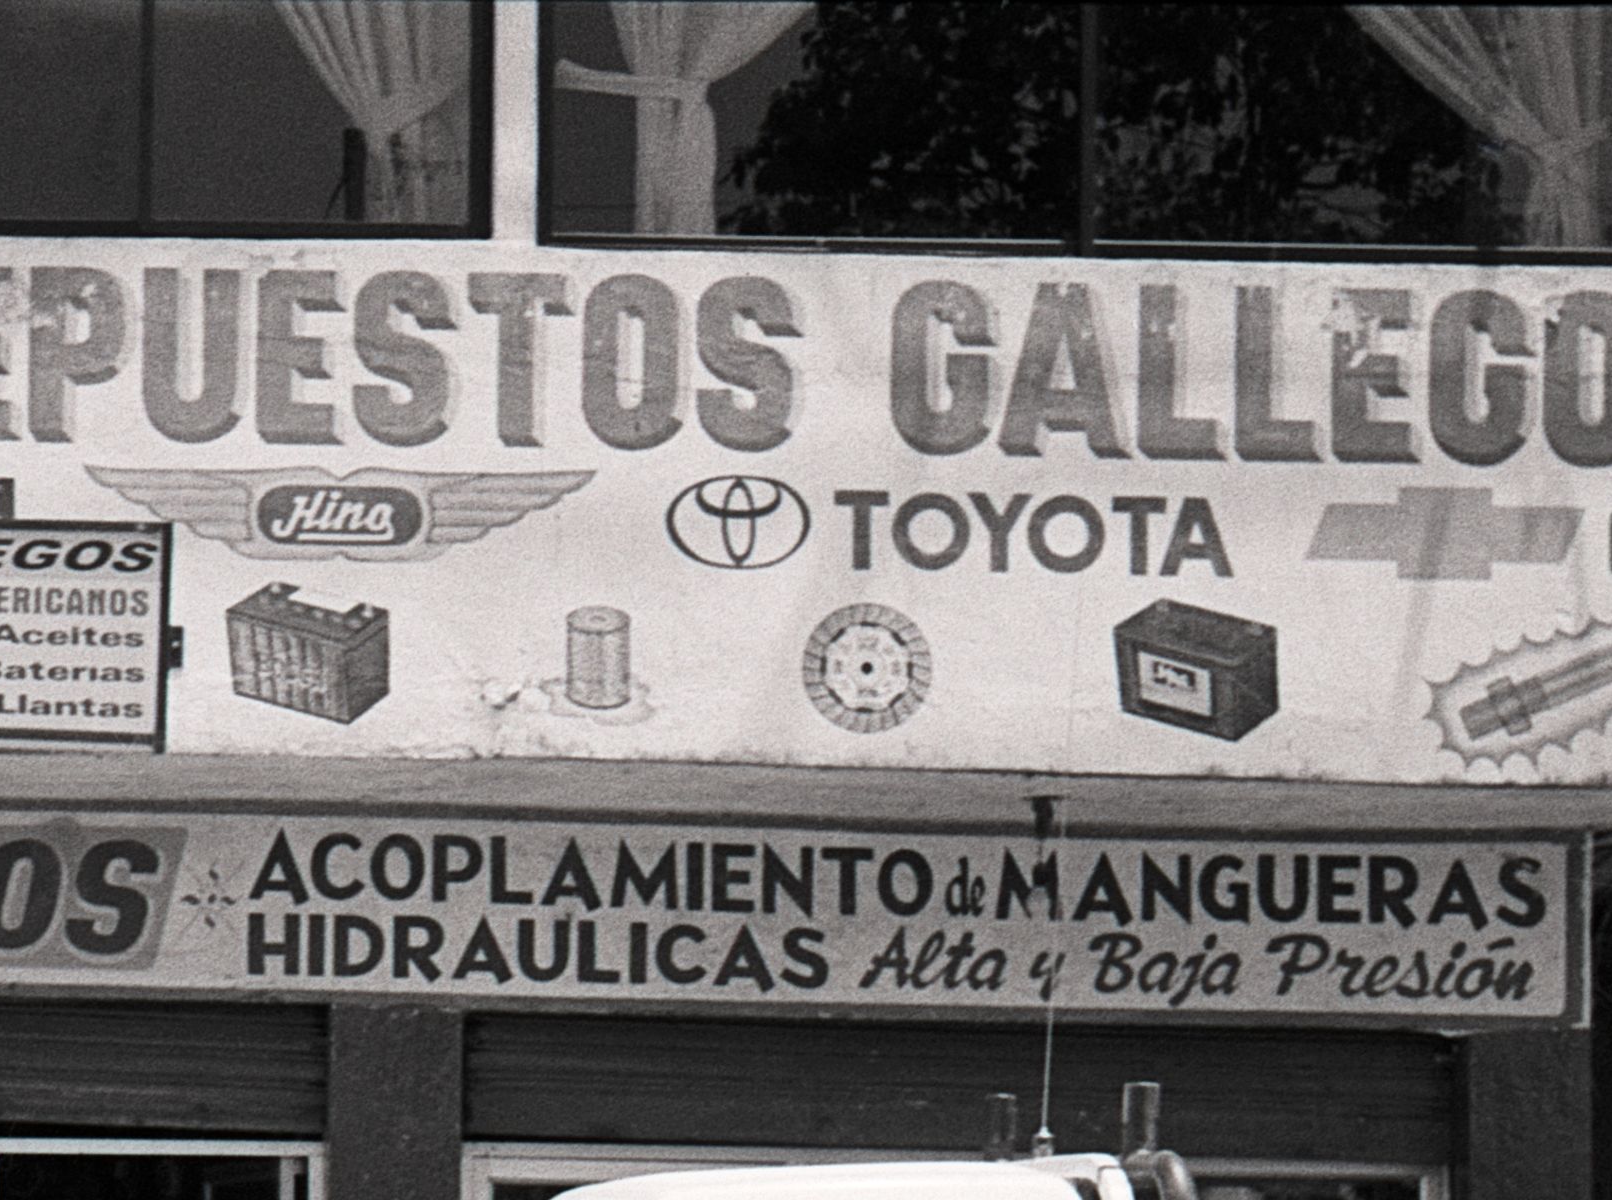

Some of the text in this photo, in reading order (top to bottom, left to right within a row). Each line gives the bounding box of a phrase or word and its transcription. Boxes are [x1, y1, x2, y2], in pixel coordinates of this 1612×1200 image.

[272, 489, 394, 541] Hino
[833, 487, 1234, 579] TOYOTA
[248, 826, 1547, 930] ACOPLAMIENTO de MANGUERAS
[246, 911, 1536, 1005] HIDRAULICAS Alta y Baja Presión
